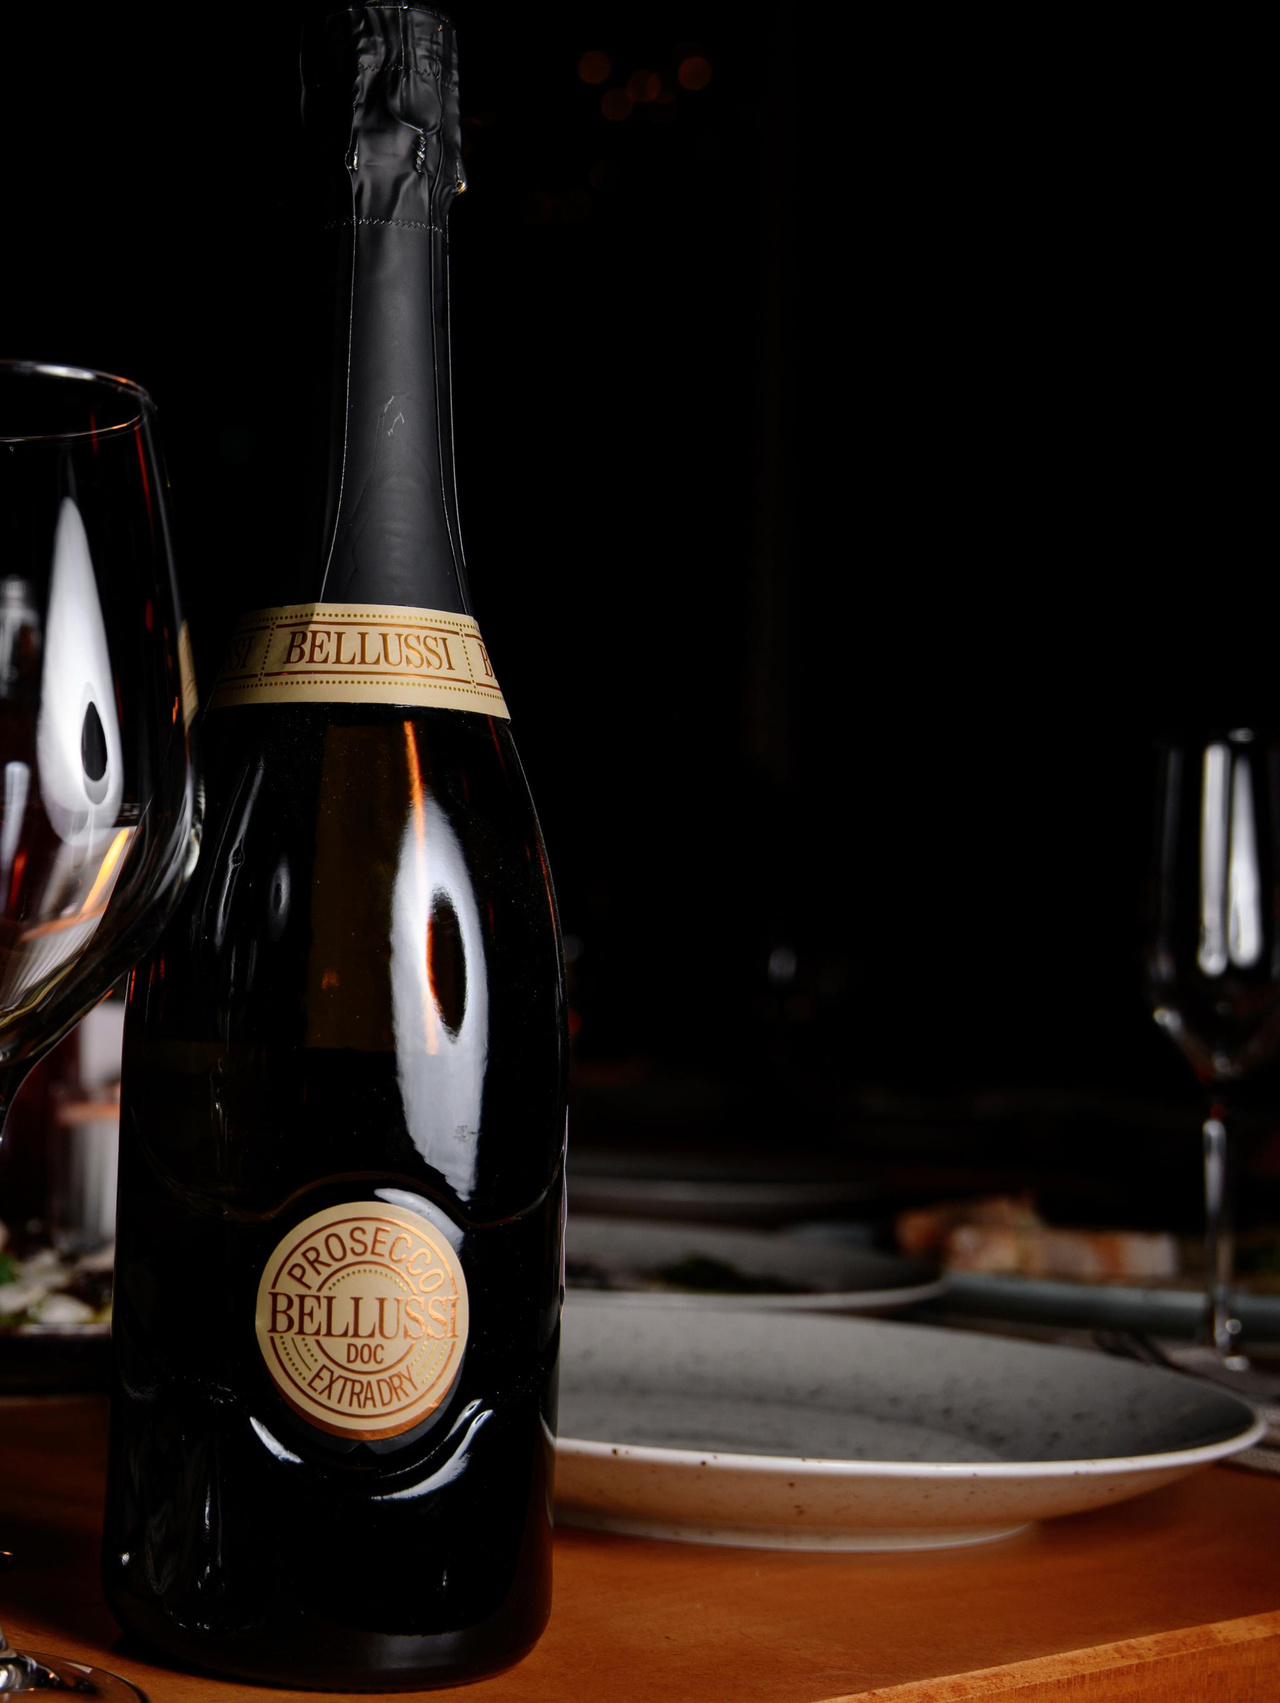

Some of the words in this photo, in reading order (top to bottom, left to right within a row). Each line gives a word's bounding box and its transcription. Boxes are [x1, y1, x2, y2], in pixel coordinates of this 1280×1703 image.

[283, 629, 456, 671] BELLUSSI
[286, 1225, 445, 1294] PROSECCO
[267, 1291, 460, 1341] BELLUSSI
[346, 1342, 385, 1365] DOC
